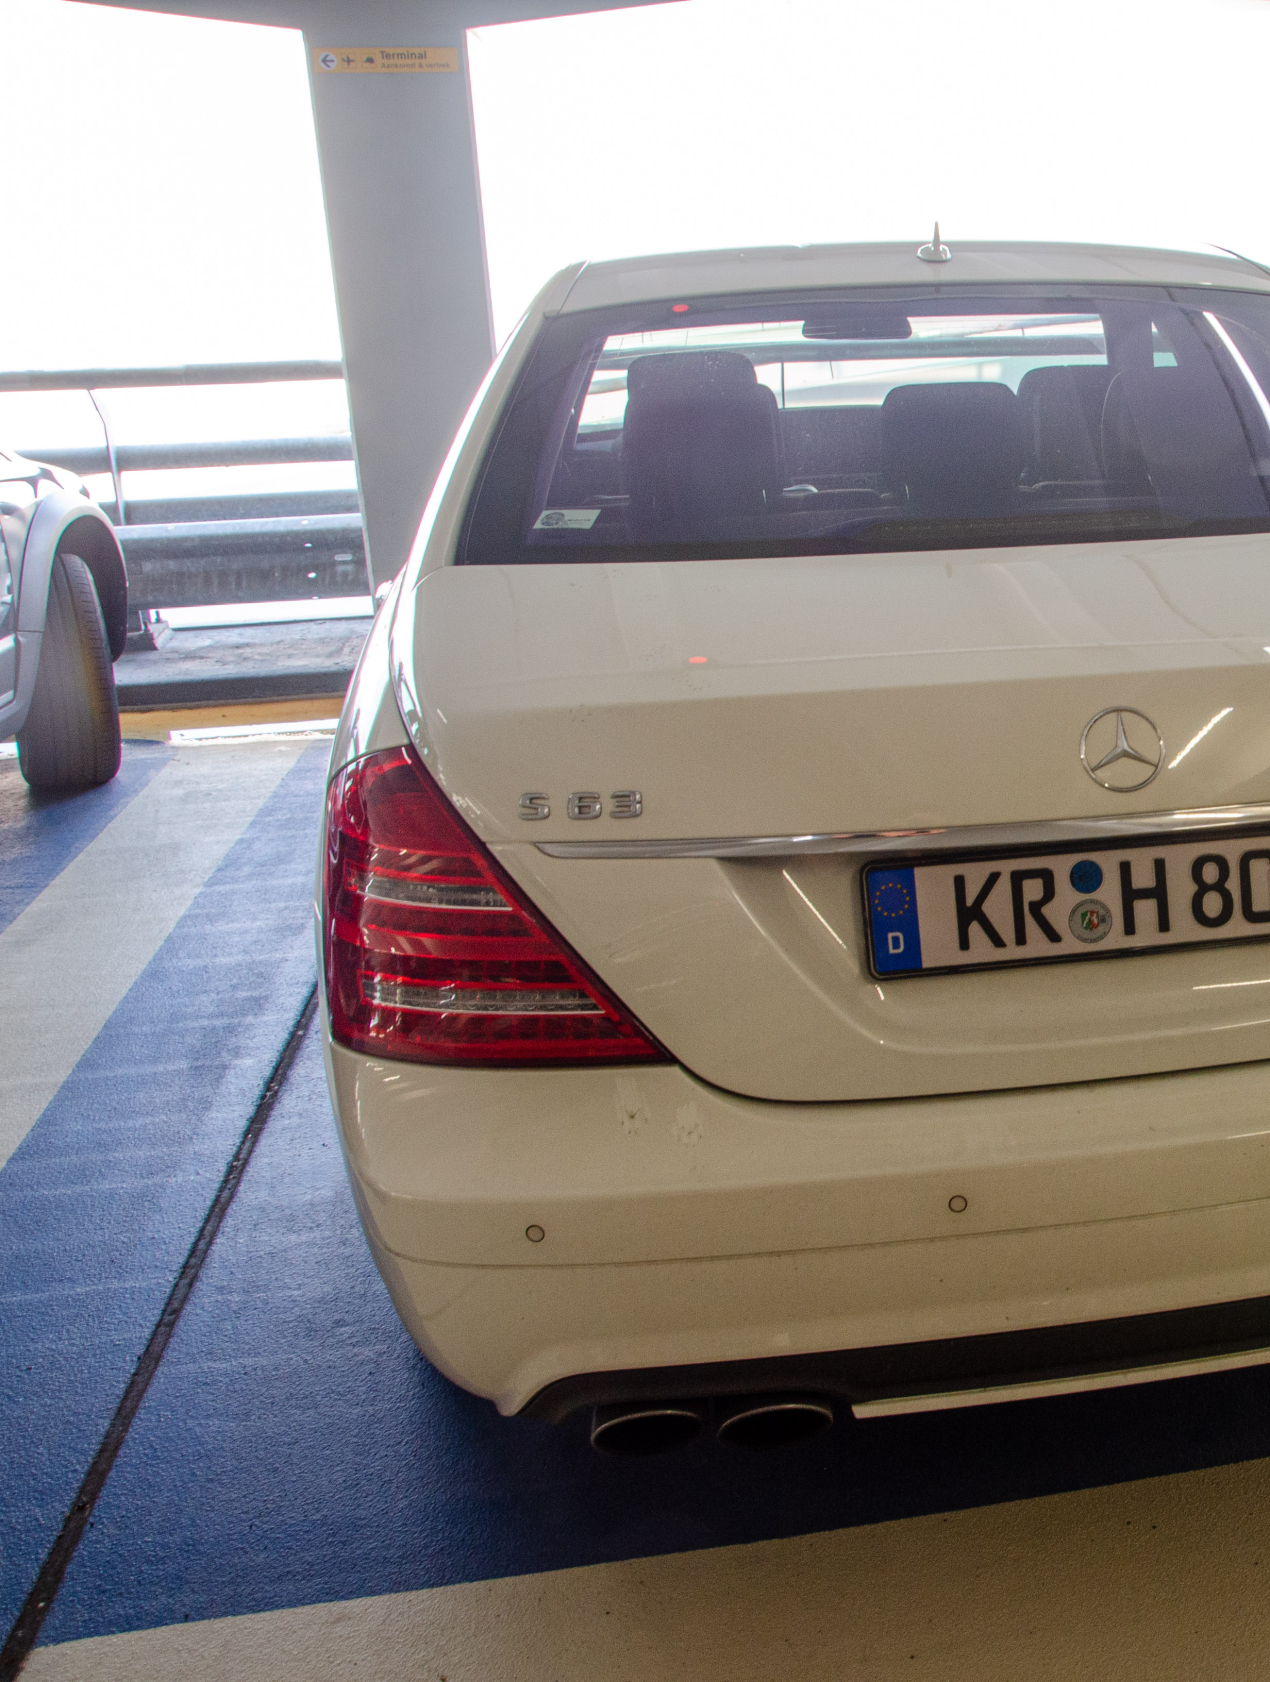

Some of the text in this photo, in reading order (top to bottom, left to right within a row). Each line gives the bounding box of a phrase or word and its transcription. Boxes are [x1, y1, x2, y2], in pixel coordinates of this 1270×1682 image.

[379, 50, 427, 60] Terminal
[518, 790, 643, 821] S 63
[954, 868, 1062, 951] KR
[1119, 858, 1171, 937] H
[887, 931, 905, 955] D
